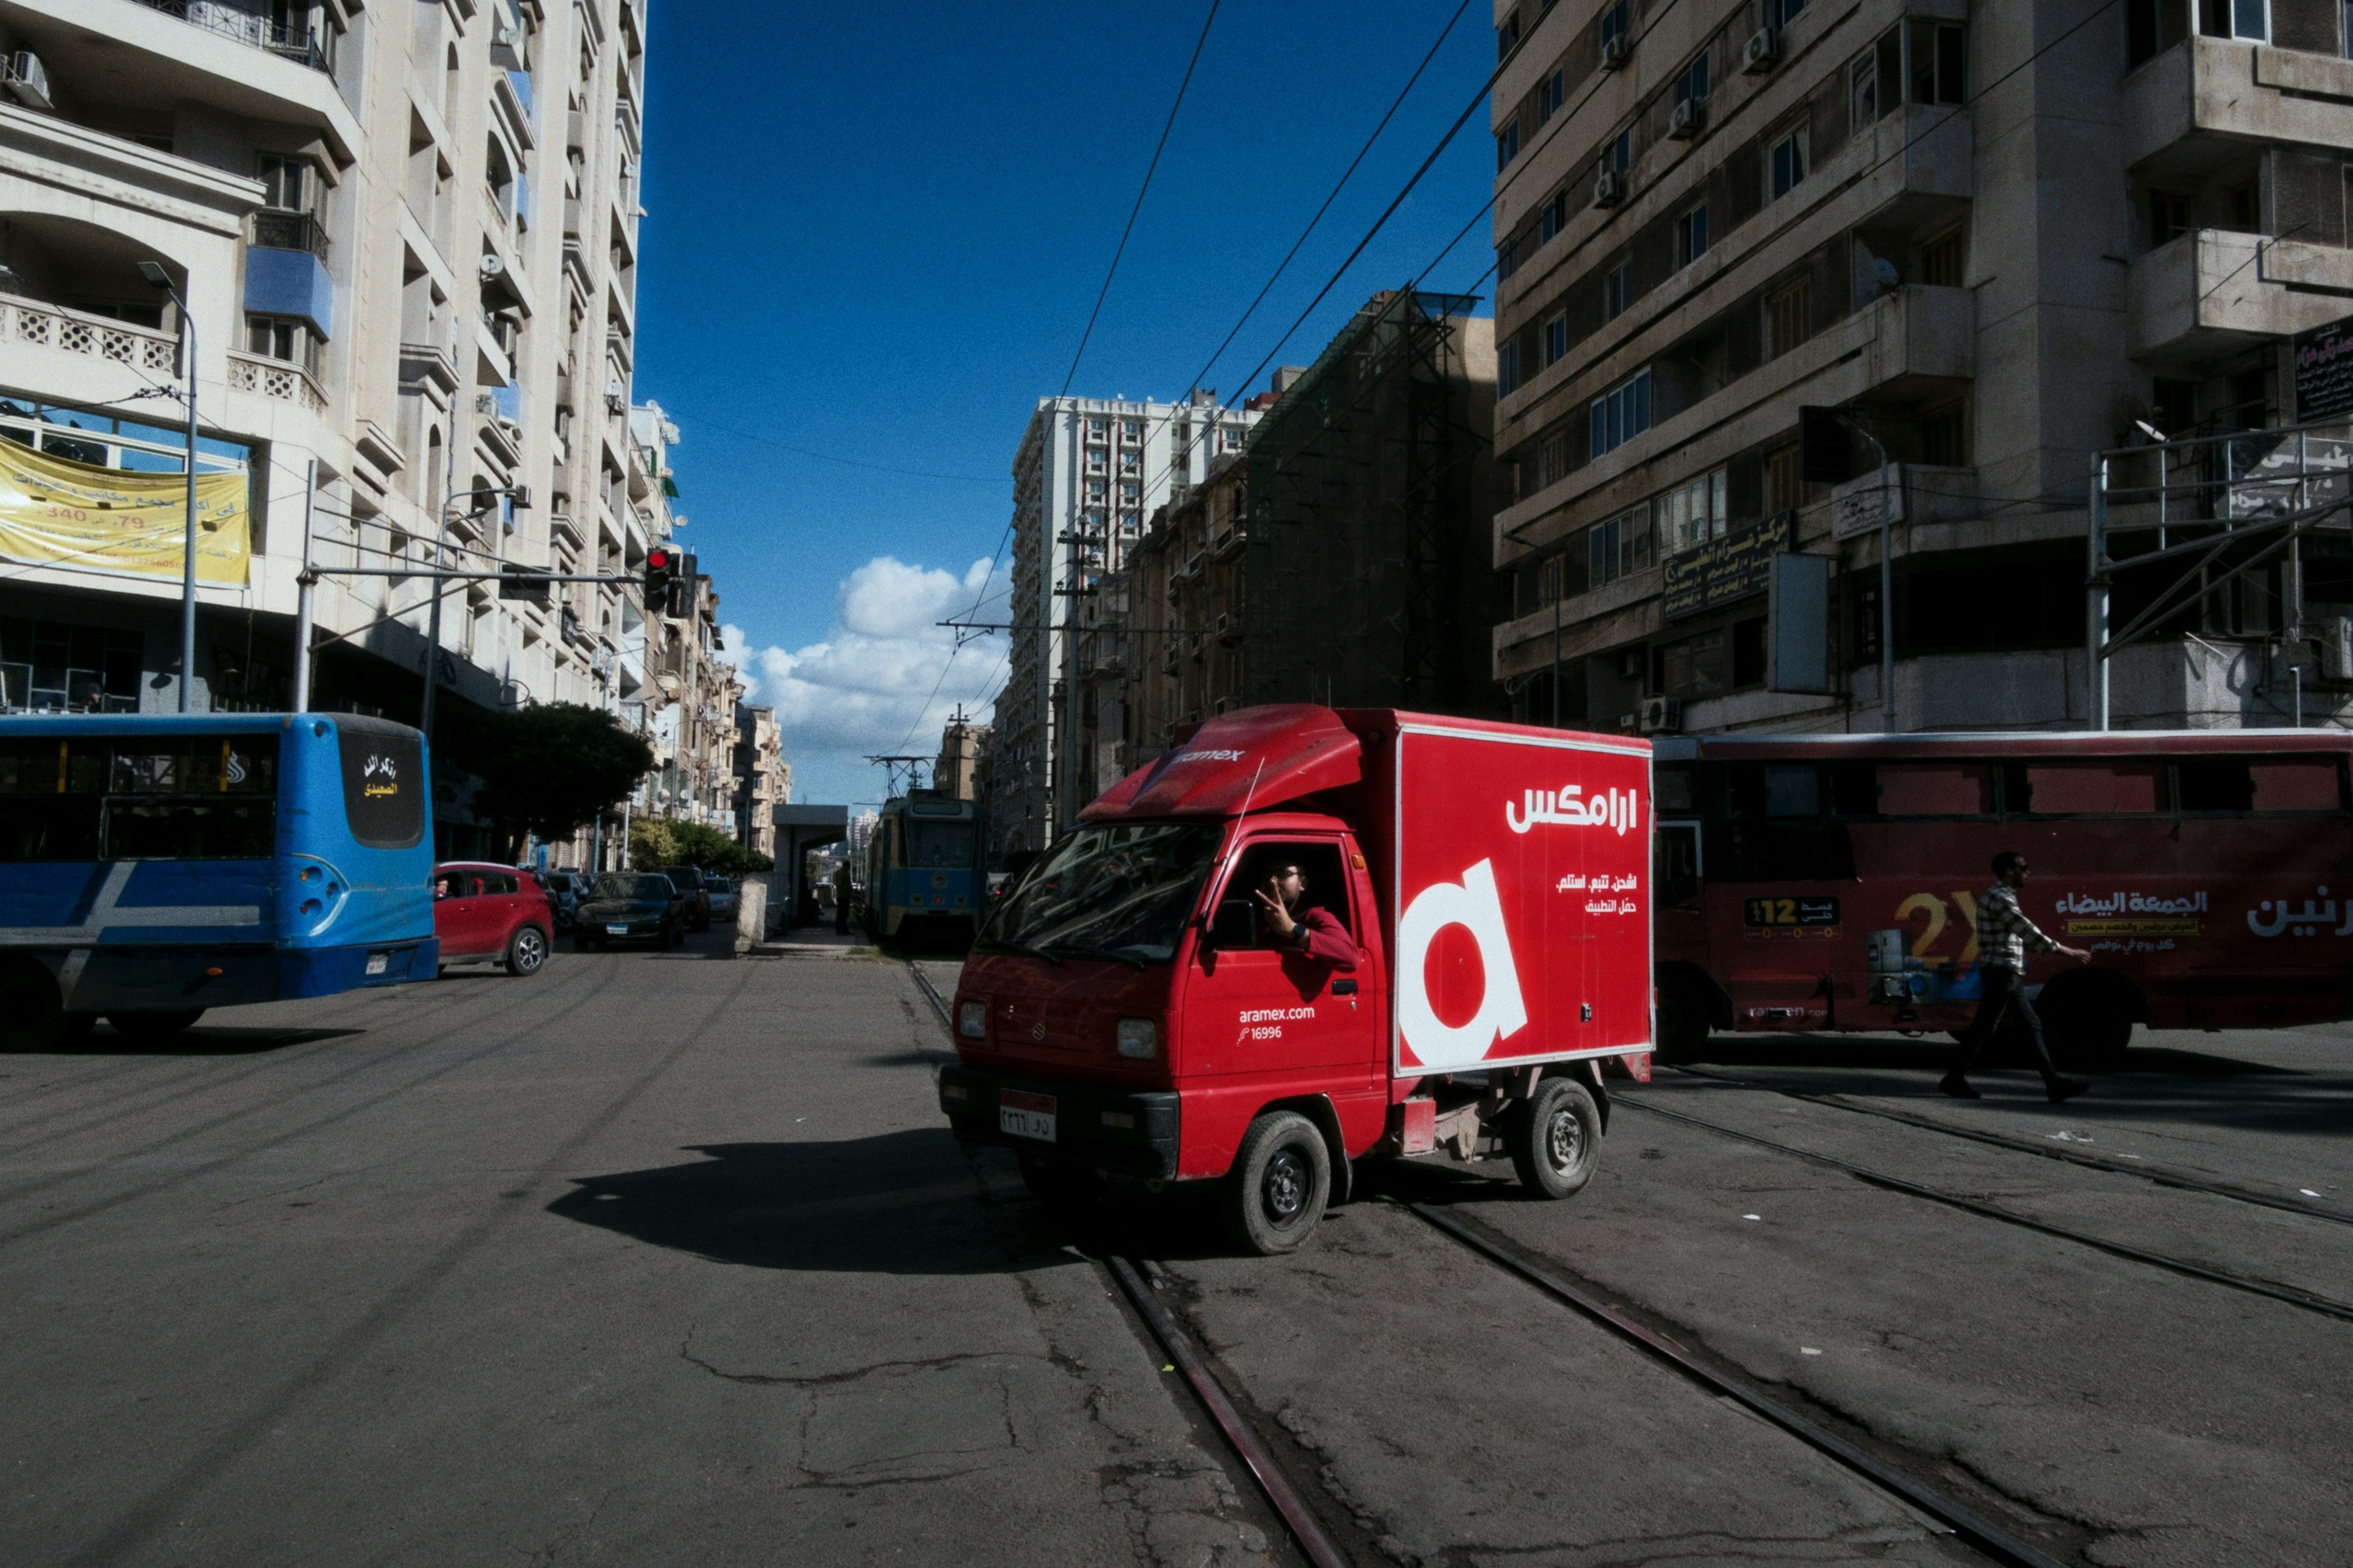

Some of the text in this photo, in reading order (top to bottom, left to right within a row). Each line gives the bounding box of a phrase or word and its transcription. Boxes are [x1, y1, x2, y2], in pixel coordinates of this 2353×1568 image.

[47, 506, 87, 523] 340
[118, 515, 145, 529] 79
[364, 754, 379, 778] الله
[1506, 784, 1637, 837] ارامكس
[1585, 899, 1617, 916] التطبيق
[1760, 898, 1799, 924] 12
[1801, 902, 1834, 911] قسط
[2055, 891, 2209, 917] الجمعة البيضاء
[1801, 911, 1834, 923] حتى
[1239, 1006, 1316, 1023] aramex.com
[1251, 1026, 1283, 1040] 16996
